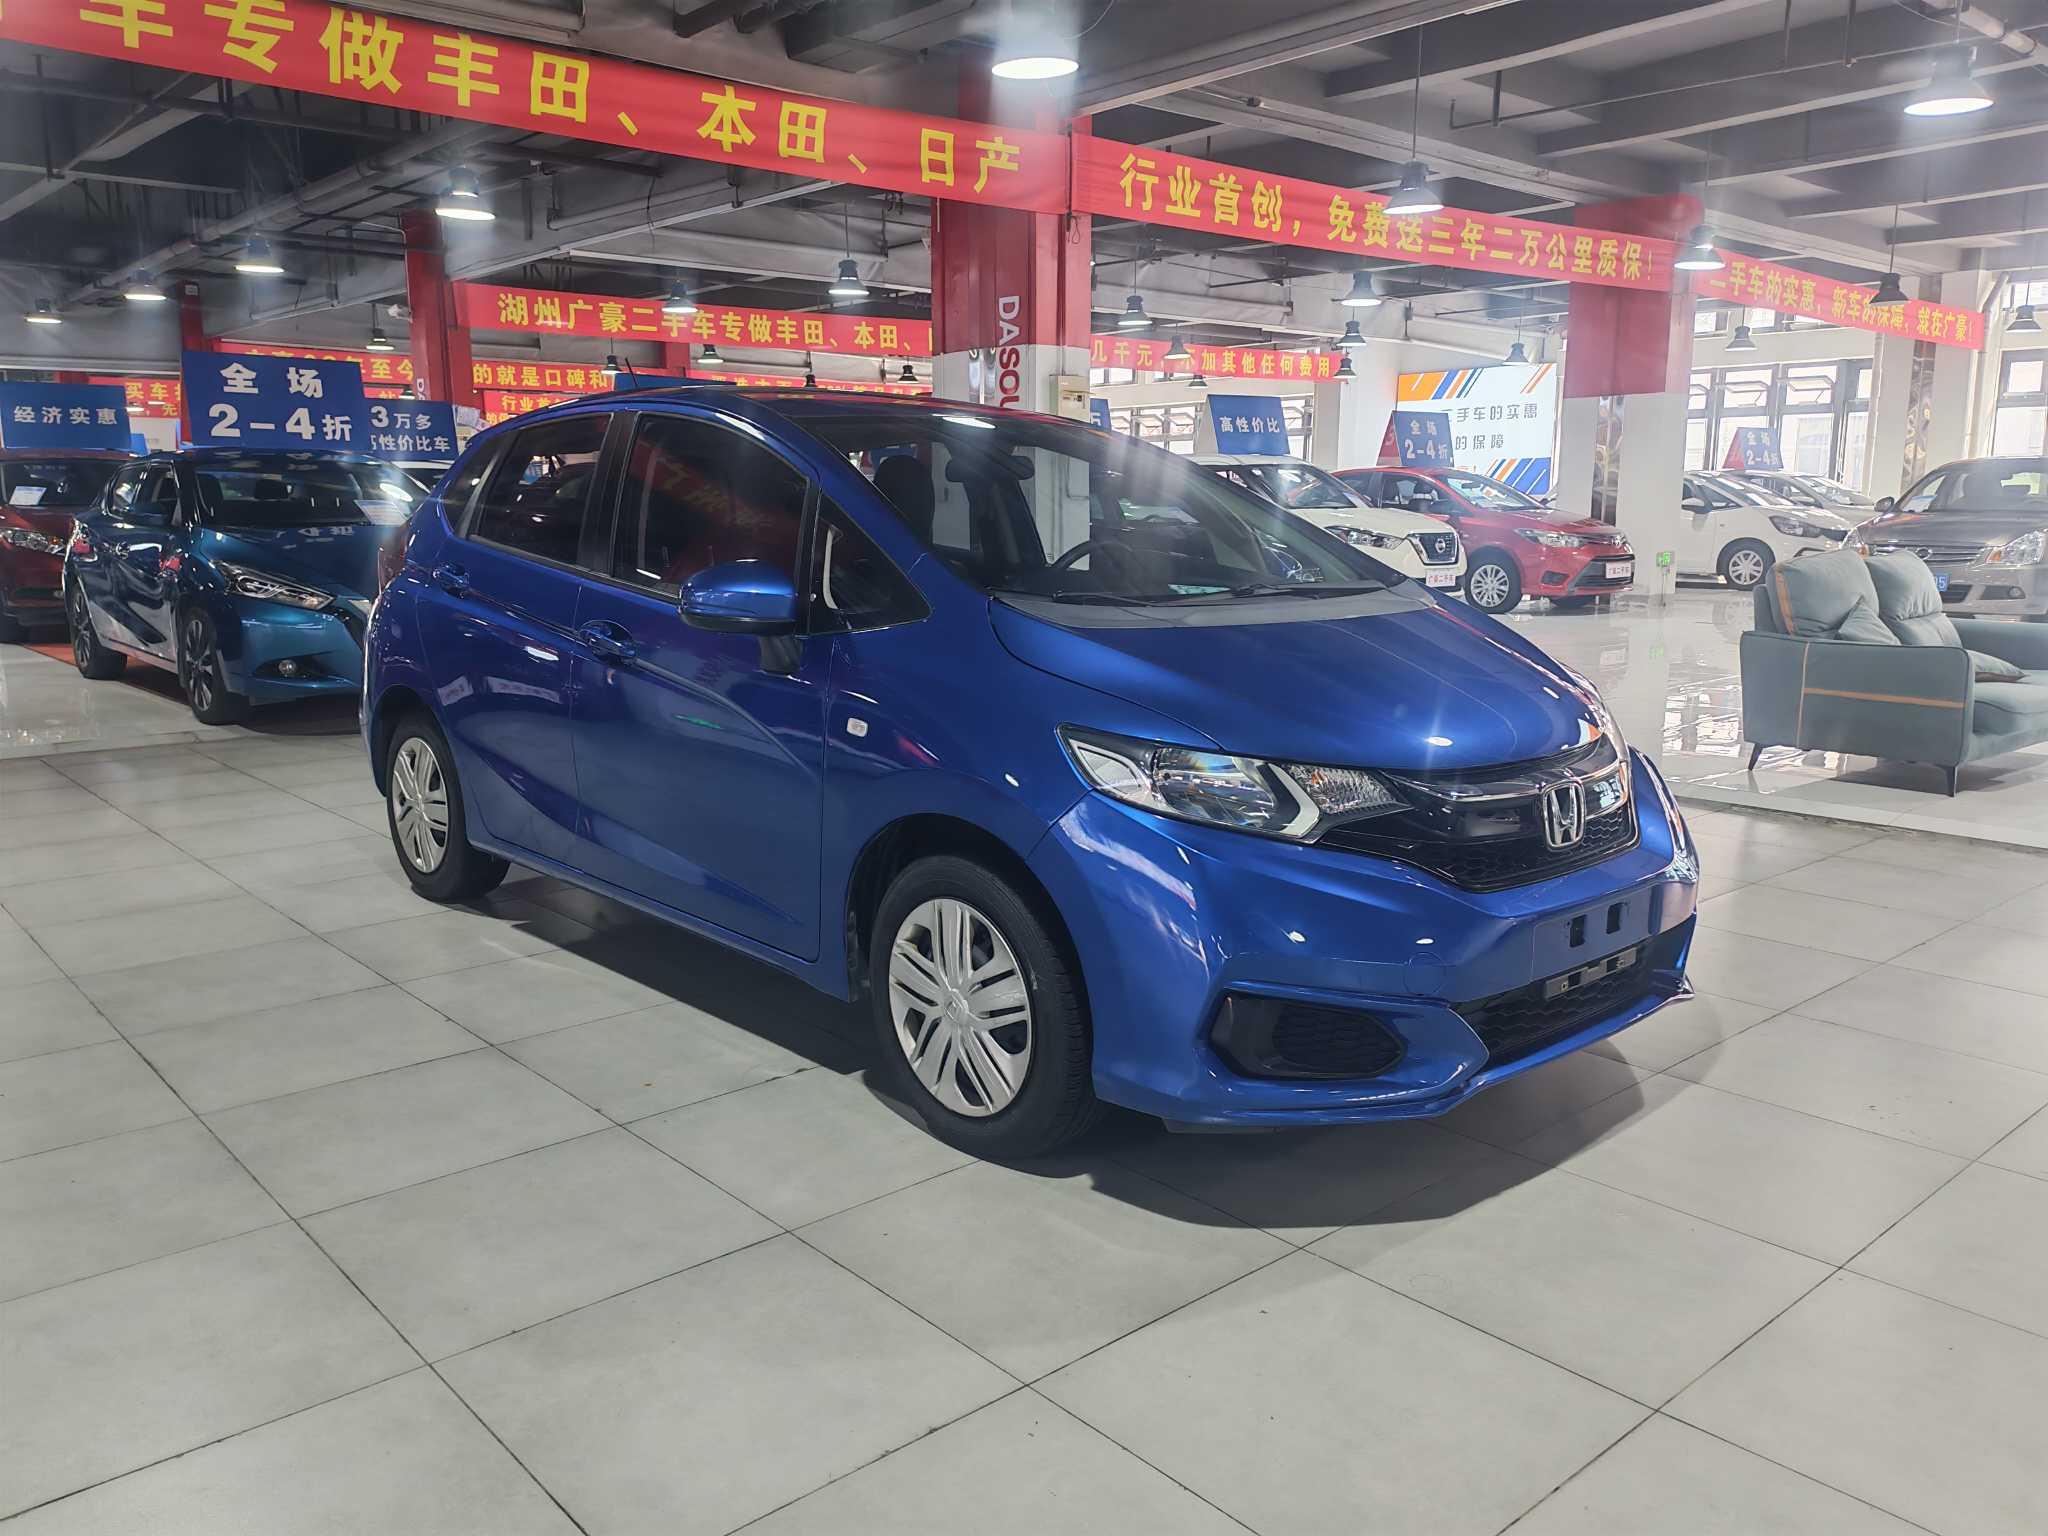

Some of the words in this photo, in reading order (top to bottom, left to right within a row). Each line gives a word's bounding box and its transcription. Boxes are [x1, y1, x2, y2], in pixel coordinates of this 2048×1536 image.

[498, 293, 932, 352] 湖州广豪二手车专做丰田、本田、
[219, 362, 323, 398] 全场
[14, 405, 118, 425] 经济实惠
[502, 395, 567, 412] 行业首
[208, 403, 352, 441] 2-4折
[370, 405, 432, 430] 3万多
[1219, 416, 1281, 433] 高性价比
